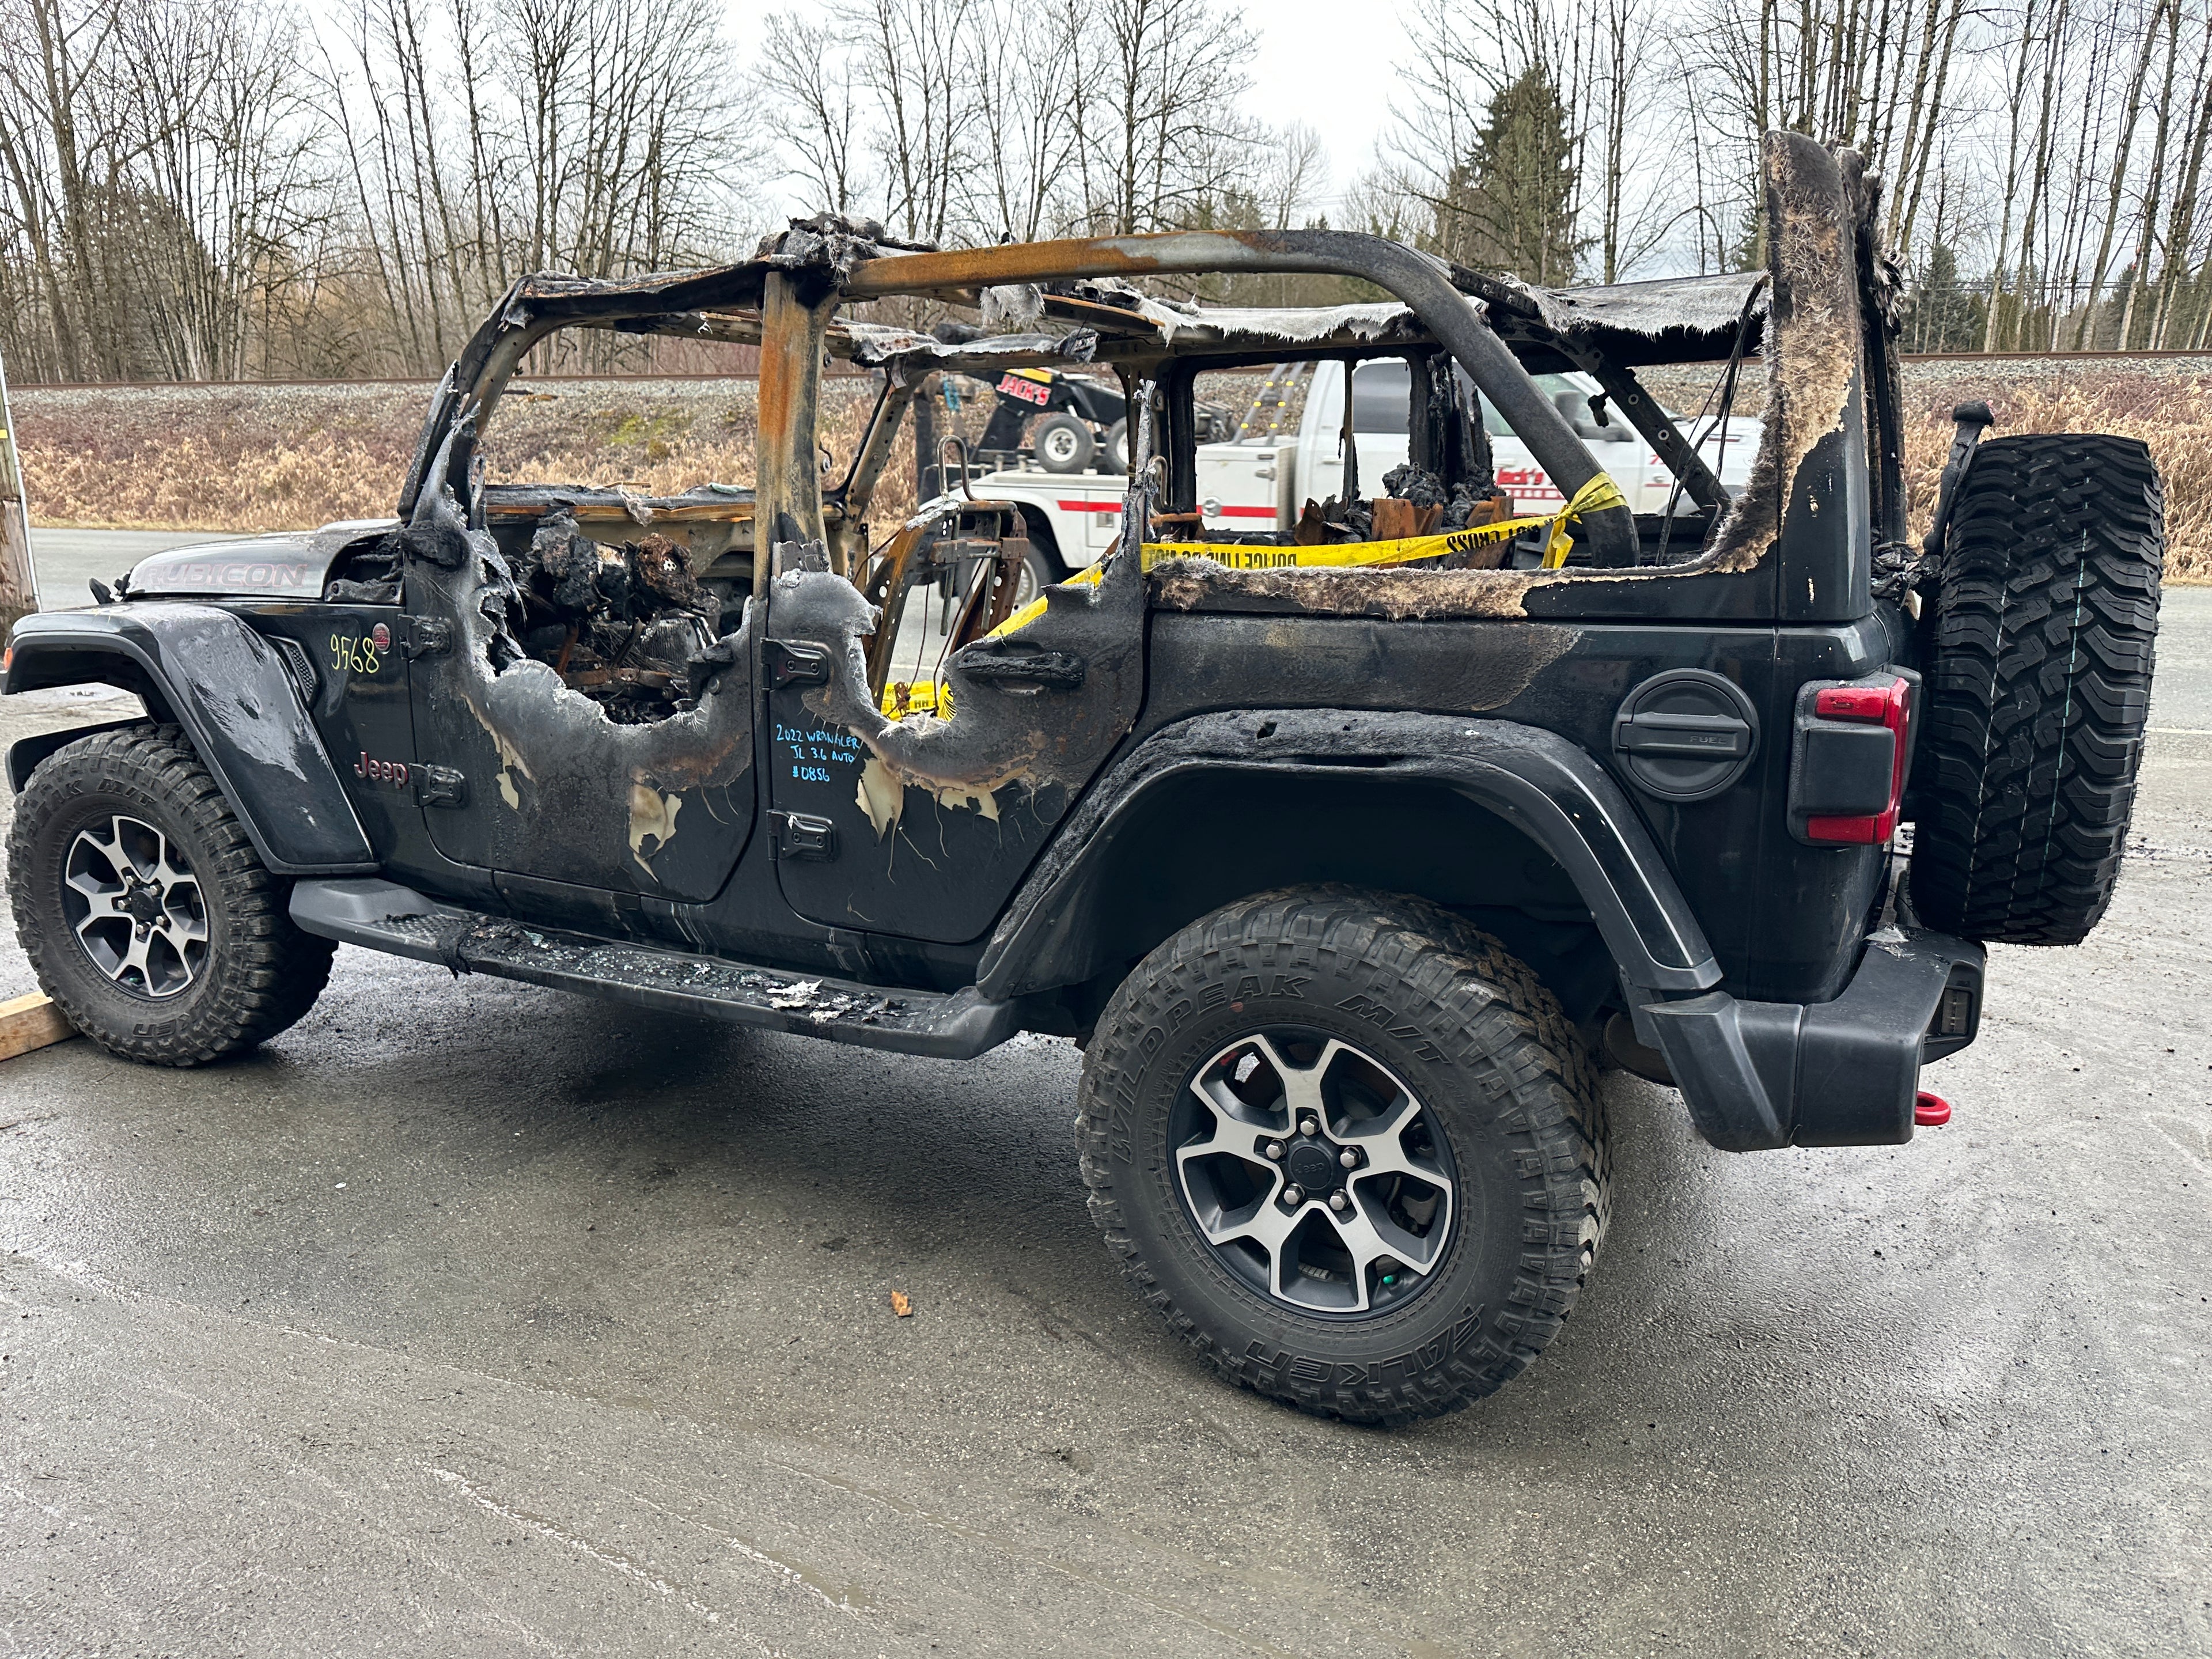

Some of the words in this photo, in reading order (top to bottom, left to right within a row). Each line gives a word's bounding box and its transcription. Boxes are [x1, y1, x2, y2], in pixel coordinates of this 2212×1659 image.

[996, 374, 1052, 406] JACK'S
[140, 563, 308, 588] RUBICON
[331, 634, 379, 673] 9568
[776, 724, 804, 742] 2022
[1690, 735, 1727, 744] FUEL
[790, 744, 805, 759] JL
[810, 747, 827, 760] 3.6
[832, 750, 855, 763] AUTO
[354, 751, 408, 789] Jeep
[1111, 973, 1313, 1165] WILDPEAK
[1244, 1302, 1486, 1385] FALKEN
